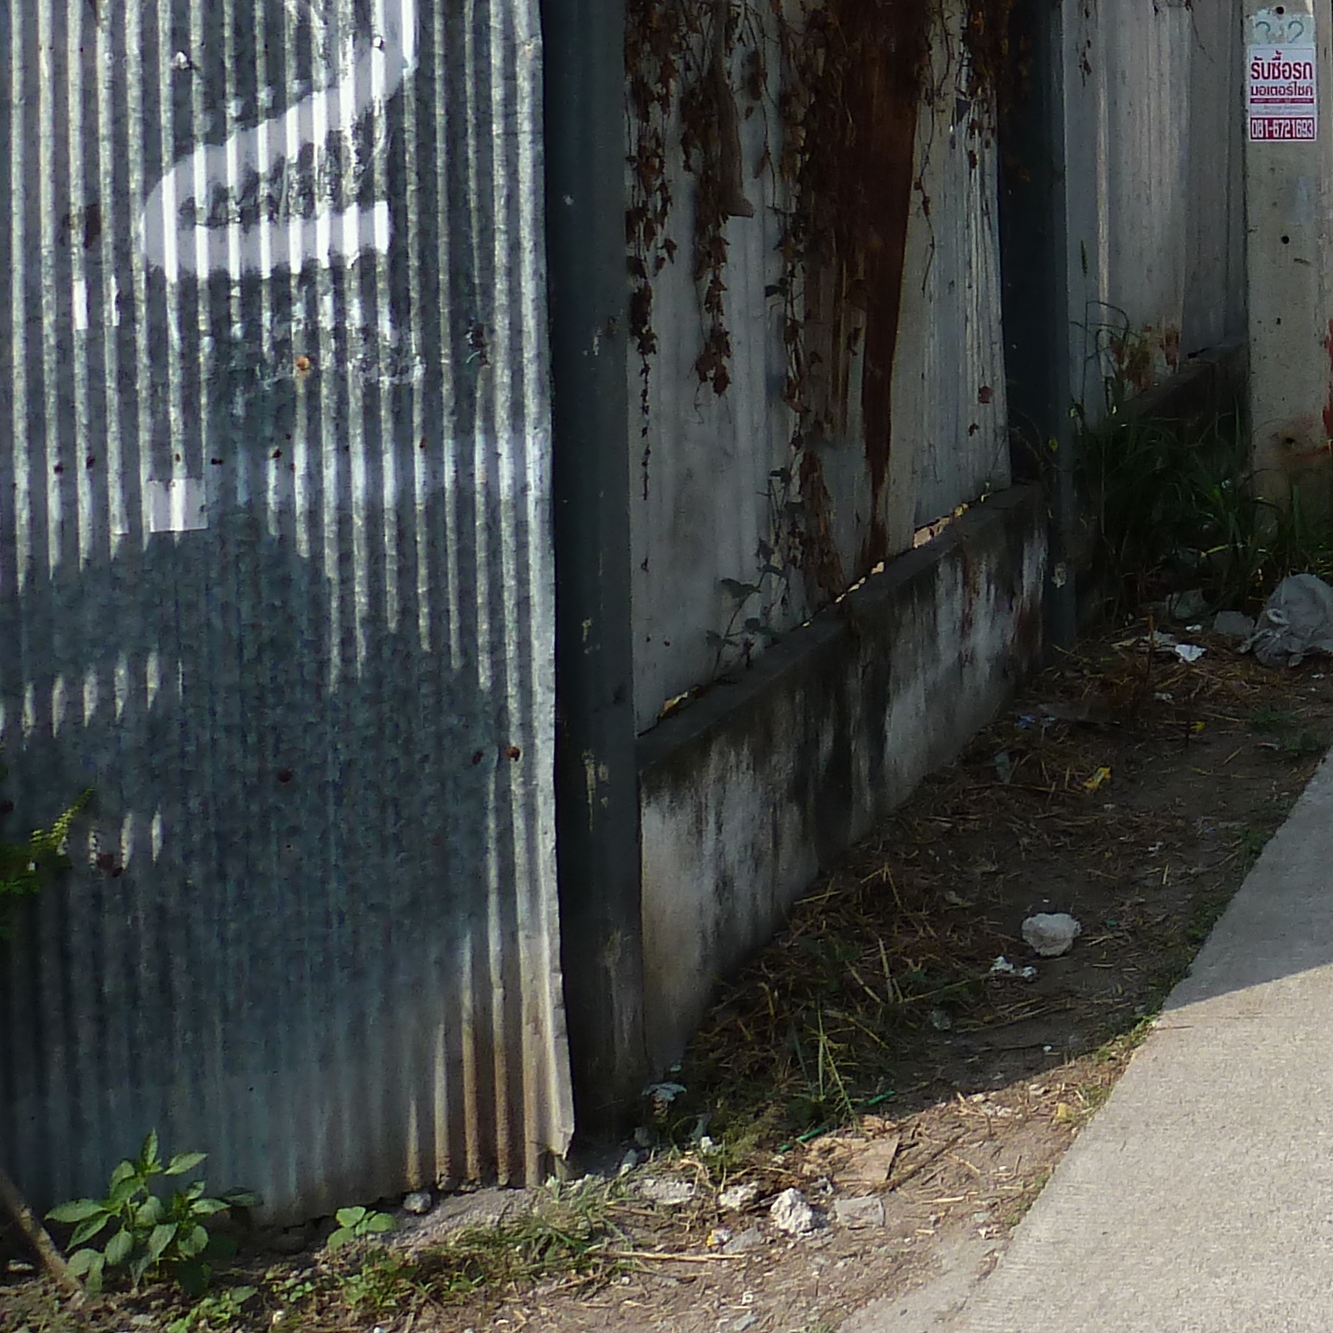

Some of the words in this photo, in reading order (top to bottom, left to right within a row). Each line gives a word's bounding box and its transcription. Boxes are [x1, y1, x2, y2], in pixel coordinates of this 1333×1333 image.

[1250, 50, 1313, 80] รับซื้อรถ
[1251, 119, 1314, 138] 081-6721693
